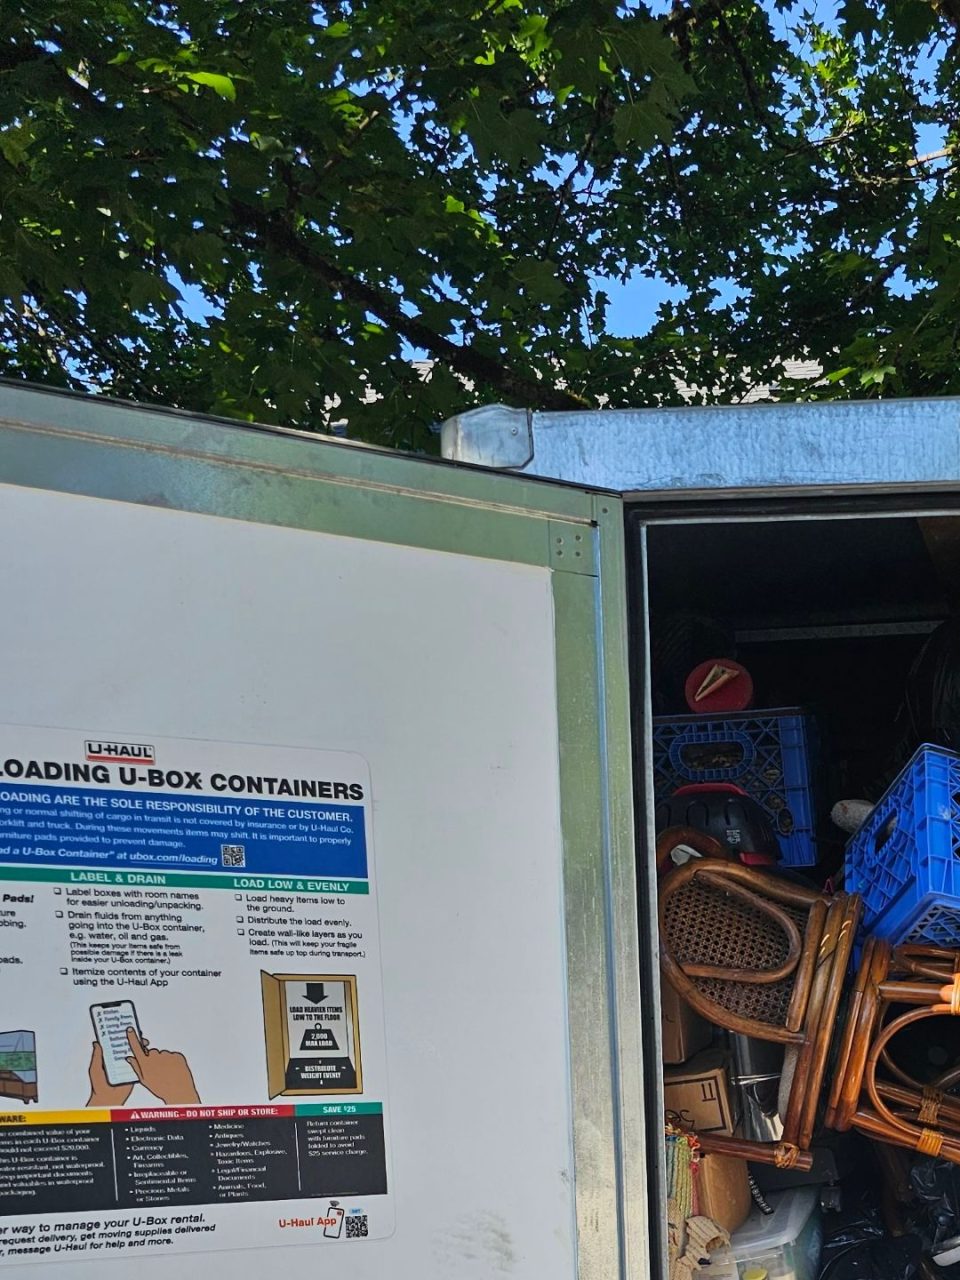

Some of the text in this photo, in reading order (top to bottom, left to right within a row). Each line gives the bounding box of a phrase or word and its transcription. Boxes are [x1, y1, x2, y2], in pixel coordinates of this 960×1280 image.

[88, 743, 153, 758] U-HAUL
[0, 758, 363, 800] OADING U-BOX CONTAINERS
[54, 795, 79, 805] ARE
[82, 796, 107, 806] THE
[110, 798, 142, 809] SOLE
[145, 800, 241, 814] RESPONSIBILITY
[244, 806, 259, 815] OF
[262, 807, 284, 817] THE
[287, 809, 352, 821] CUSTOMER.
[59, 810, 93, 819] shifting
[143, 814, 171, 822] transit
[198, 818, 232, 826] covered
[234, 819, 245, 828] by
[247, 821, 286, 829] insurance
[298, 823, 309, 831] by
[310, 823, 338, 832] U-Haul
[339, 825, 353, 833] Co.
[46, 821, 70, 829] truck.
[75, 823, 105, 832] During
[106, 824, 131, 832] these
[133, 827, 183, 835] movements
[210, 831, 228, 839] may
[319, 837, 351, 845] properly
[148, 838, 185, 848] damage.
[22, 847, 55, 855] U-Box
[129, 852, 218, 864] ubox.com/loading
[70, 872, 165, 884] LABEL & DRAIN
[233, 879, 349, 891] LOAD LOW & EVENLY
[65, 887, 91, 895] Label
[93, 888, 121, 897] boxes
[3, 894, 35, 903] Pads!
[66, 897, 79, 905] for
[110, 899, 203, 910] unloading/unpacking.
[245, 894, 267, 902] Load
[269, 895, 294, 904] heavy
[262, 905, 294, 913] ground.
[94, 911, 119, 919] fluids
[121, 912, 142, 920] from
[144, 913, 182, 923] anything
[247, 916, 287, 924] Distribute
[323, 919, 351, 927] evenly.
[68, 921, 94, 930] going
[115, 922, 130, 930] the
[132, 922, 160, 930] U-Box
[162, 924, 204, 932] container,
[69, 932, 85, 940] e.g.
[88, 932, 115, 940] water,
[130, 932, 147, 940] and
[149, 934, 168, 942] gas.
[277, 929, 310, 937] wall-like
[311, 930, 335, 939] layers
[72, 967, 105, 975] Itemize
[73, 978, 97, 986] using
[149, 978, 168, 986] App
[141, 1111, 179, 1119] WARNING
[186, 1110, 197, 1118] DO
[11, 1213, 205, 1234] way to manage your U-Box rental.
[278, 1217, 336, 1227] U-Haul App
[37, 1234, 77, 1242] delivery,
[80, 1232, 95, 1241] get
[98, 1230, 131, 1238] moving
[134, 1227, 172, 1236] supplies
[174, 1223, 215, 1233] delivered
[7, 1246, 51, 1254] message
[53, 1242, 87, 1251] U-Haul
[105, 1240, 125, 1248] help
